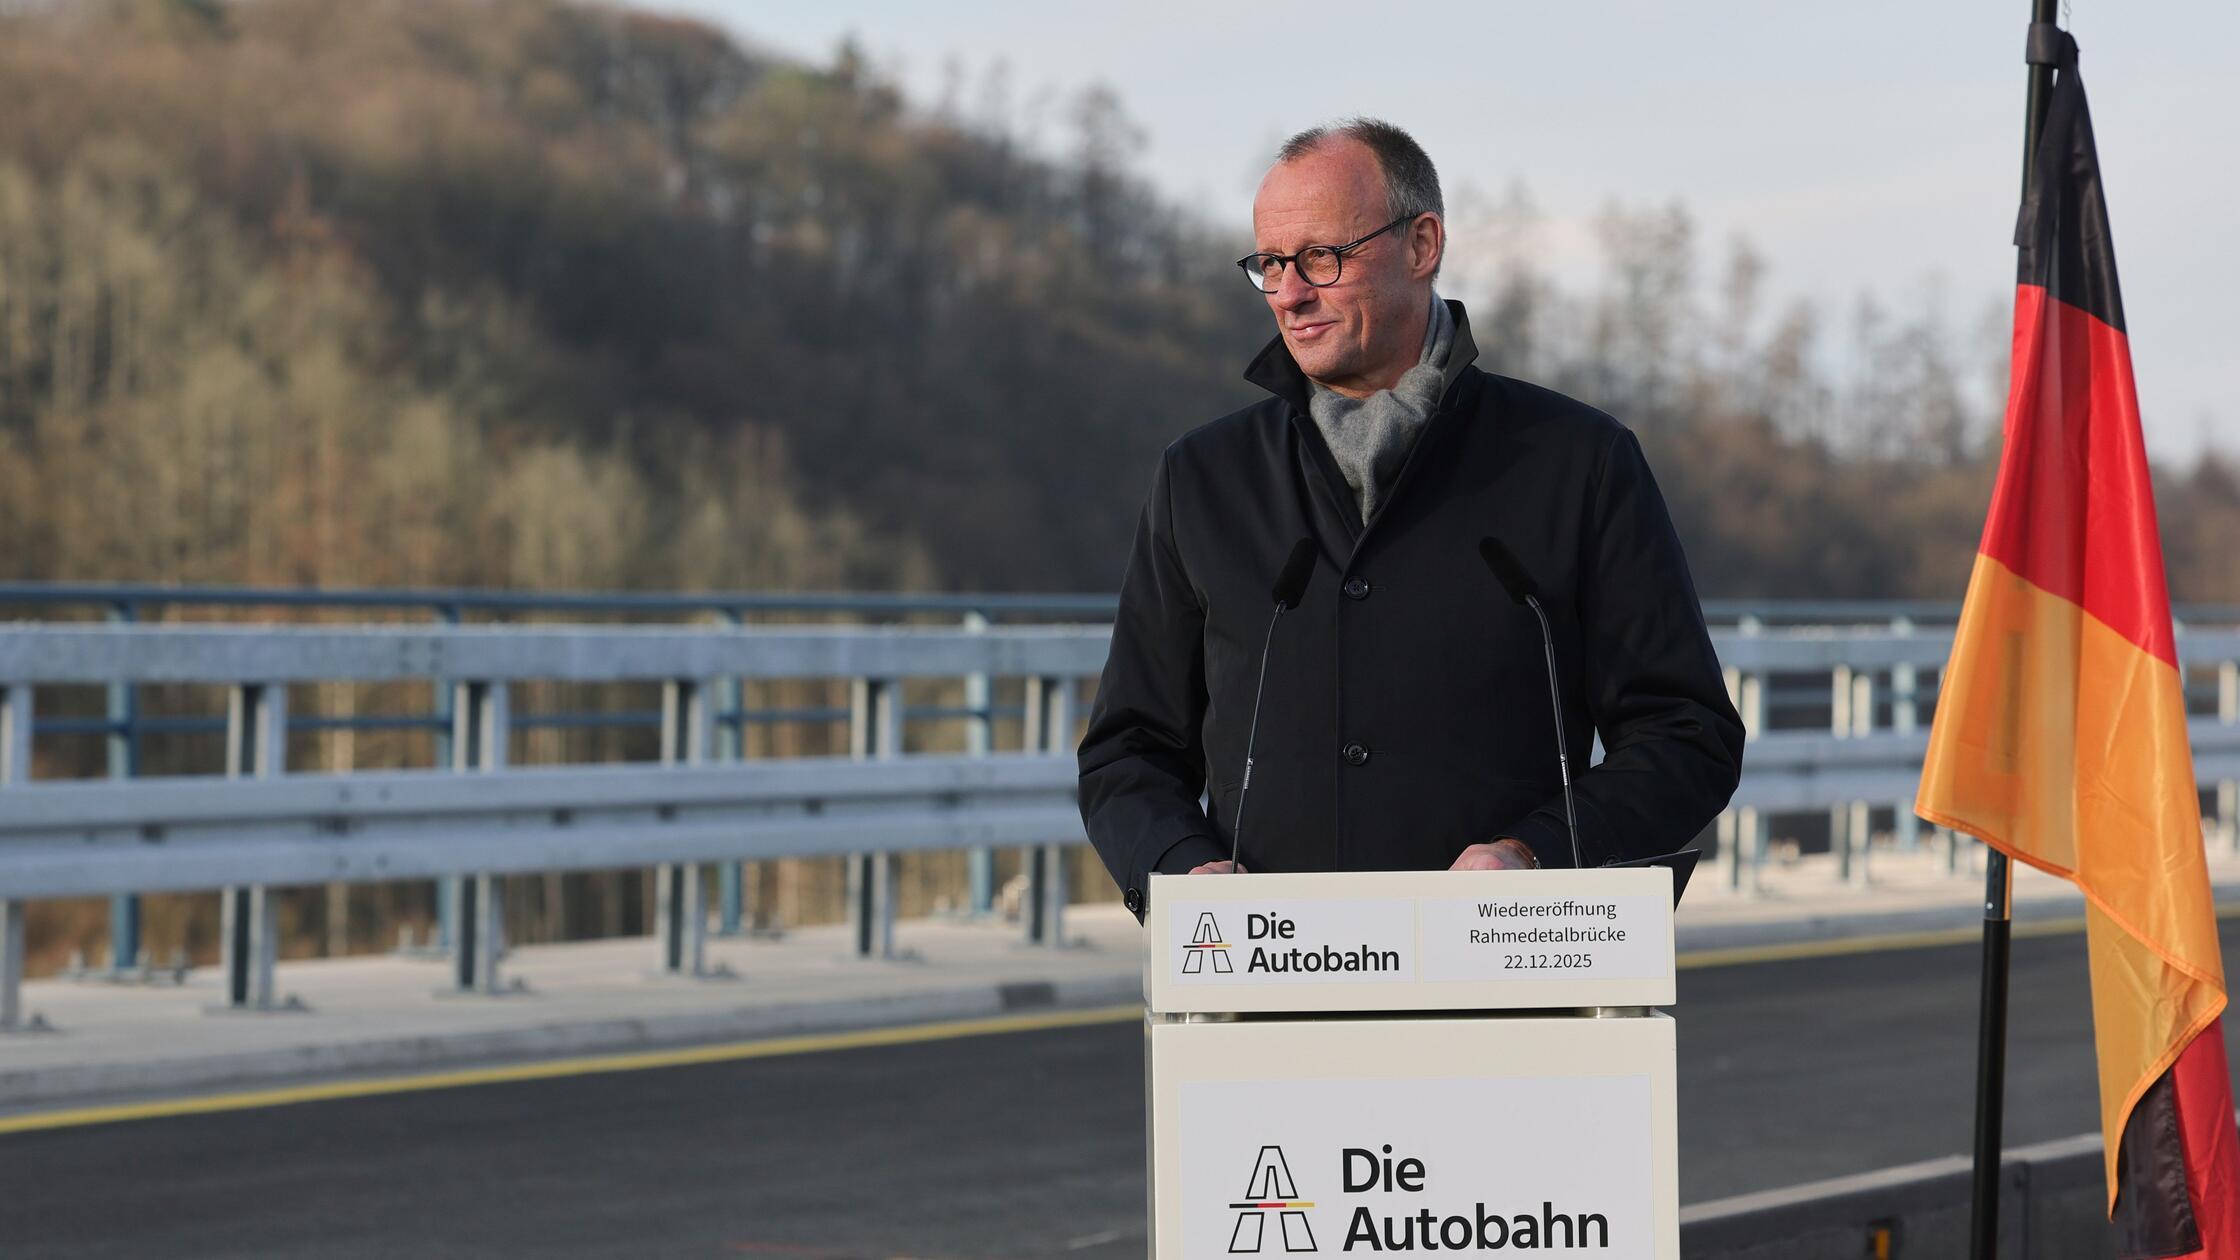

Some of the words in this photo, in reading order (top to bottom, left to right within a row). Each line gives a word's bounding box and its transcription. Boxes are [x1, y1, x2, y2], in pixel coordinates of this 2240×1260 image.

[1477, 901, 1617, 920] Wiedereröffnung
[1247, 911, 1296, 940] Die
[1470, 927, 1626, 944] Rahmedetalbrücke
[1247, 944, 1400, 974] Autobahn
[1504, 953, 1592, 969] 22.12.2025
[1342, 1143, 1426, 1194] Die
[1342, 1201, 1609, 1252] Autobahn
